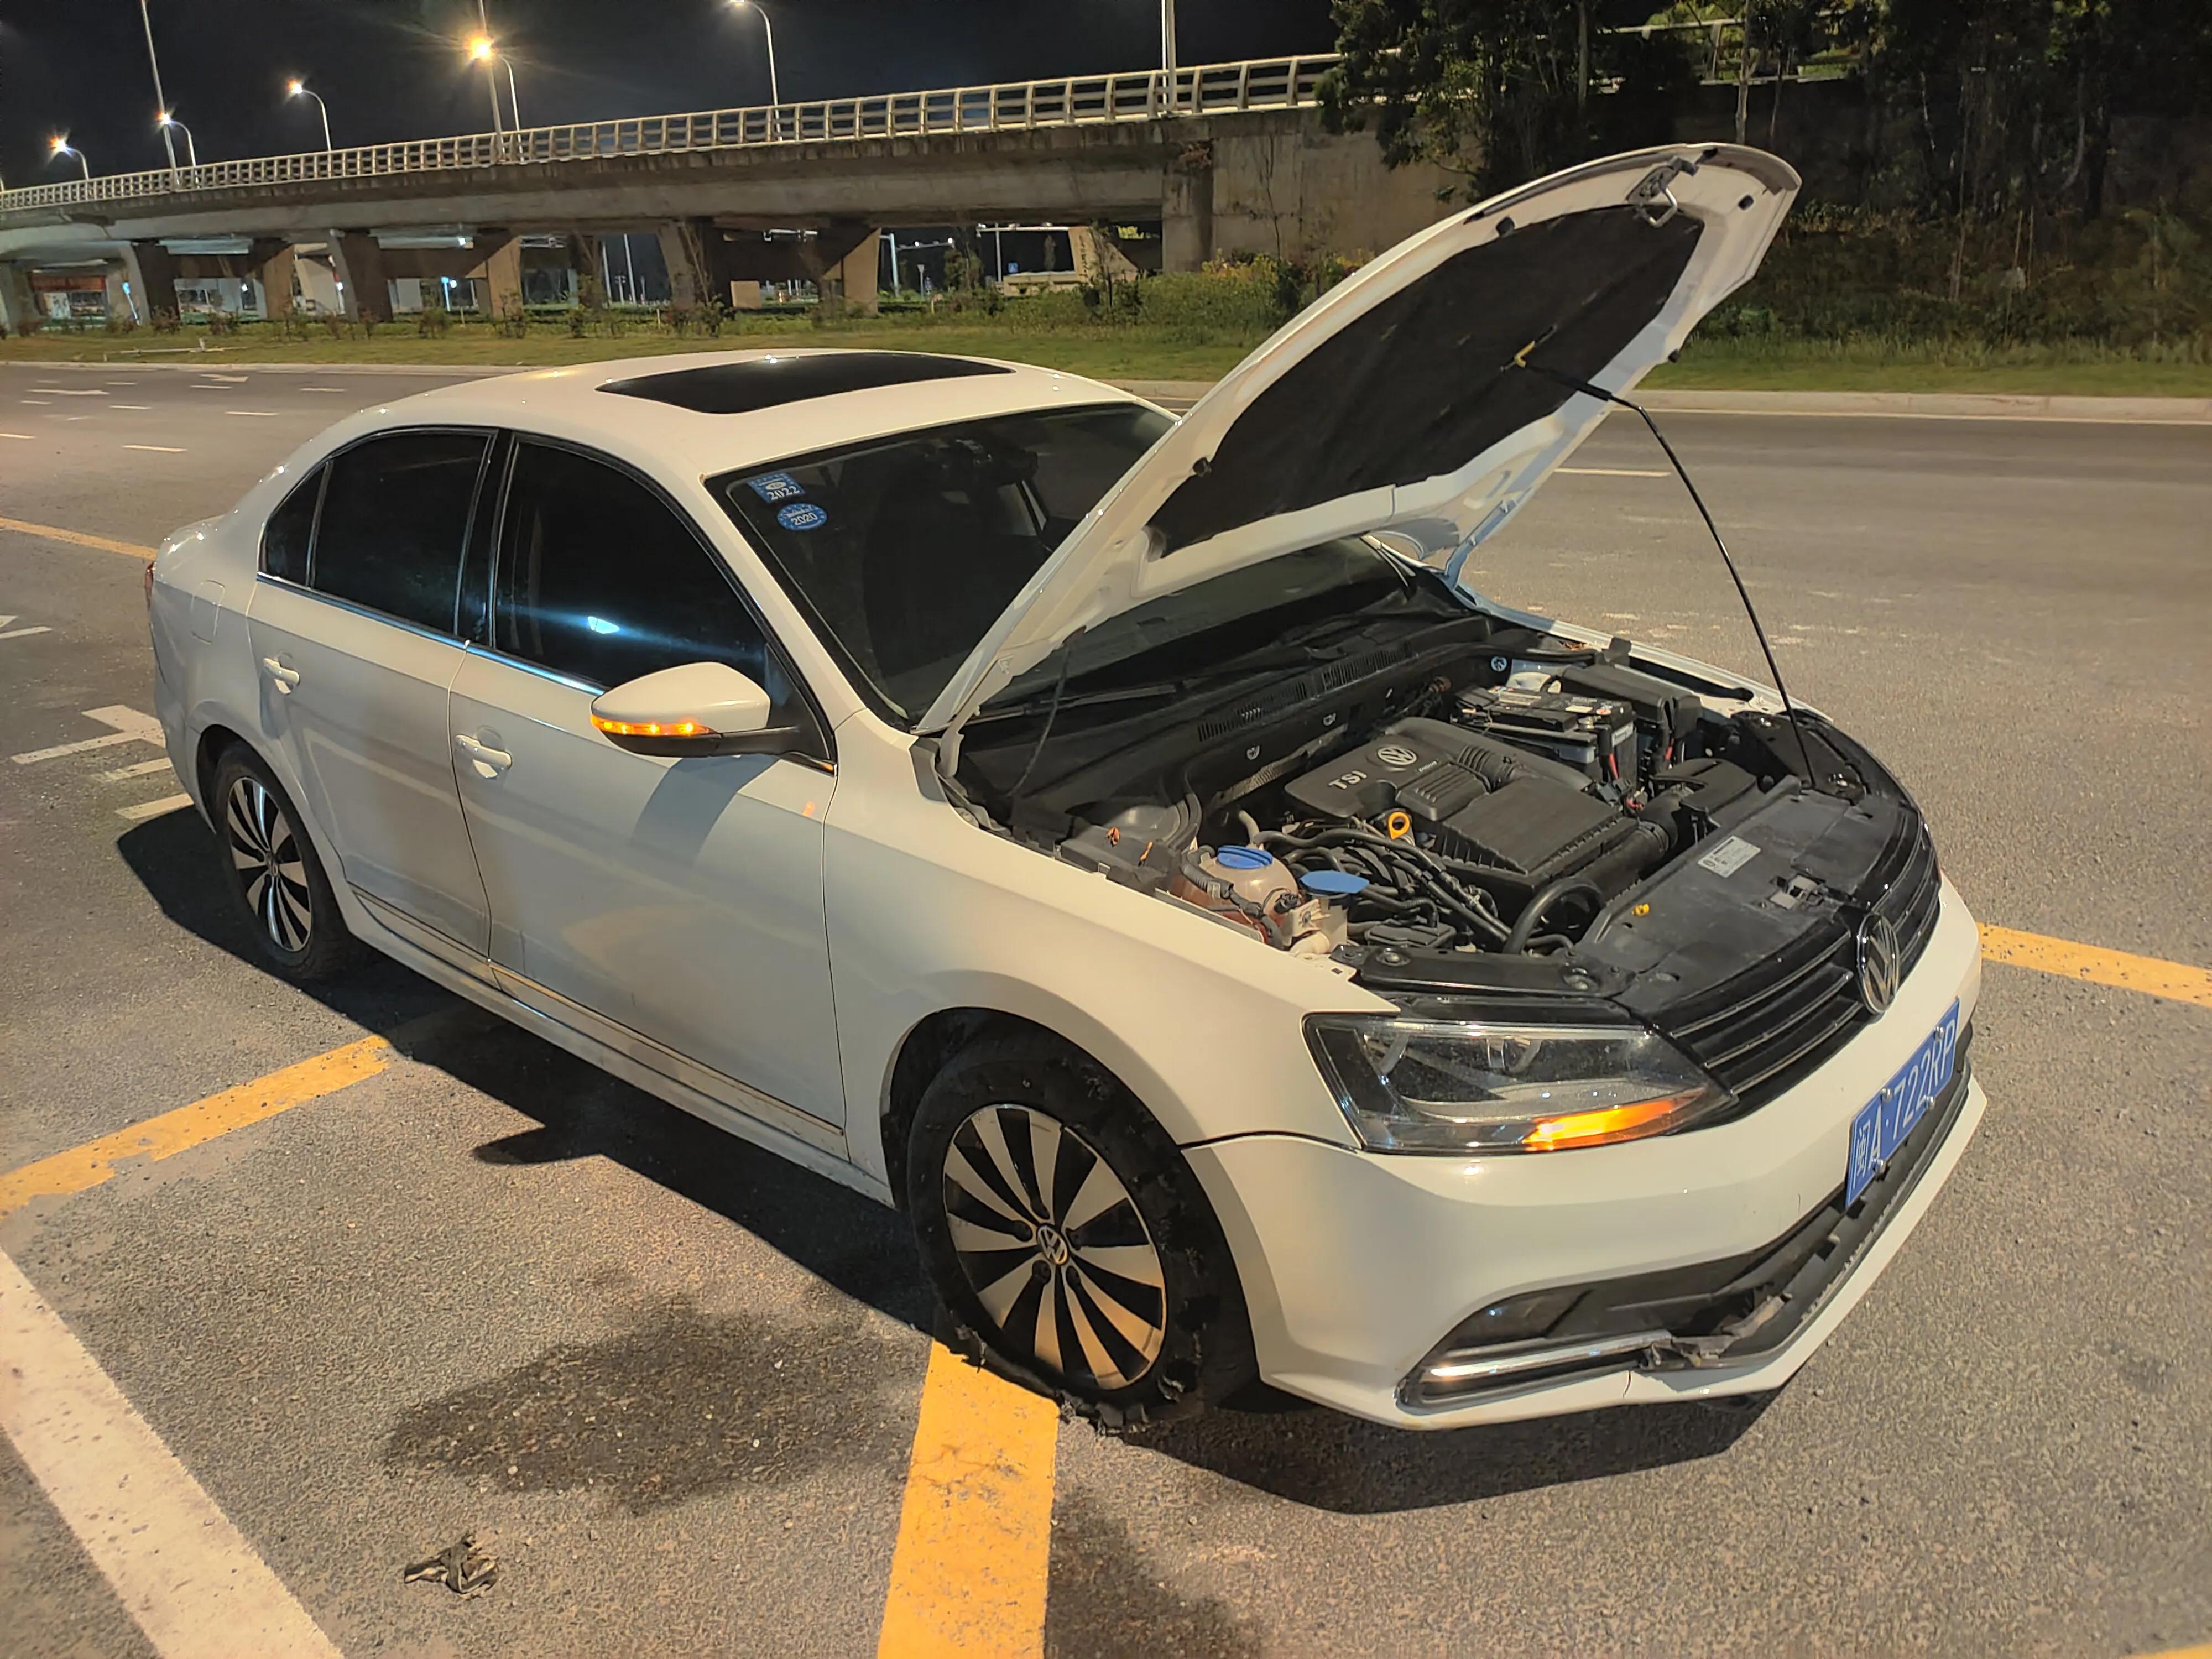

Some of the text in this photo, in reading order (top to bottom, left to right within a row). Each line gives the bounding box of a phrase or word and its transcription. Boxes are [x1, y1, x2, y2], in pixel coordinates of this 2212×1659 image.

[767, 486, 800, 500] 2022
[791, 512, 818, 525] 2020
[1328, 770, 1367, 790] TSI
